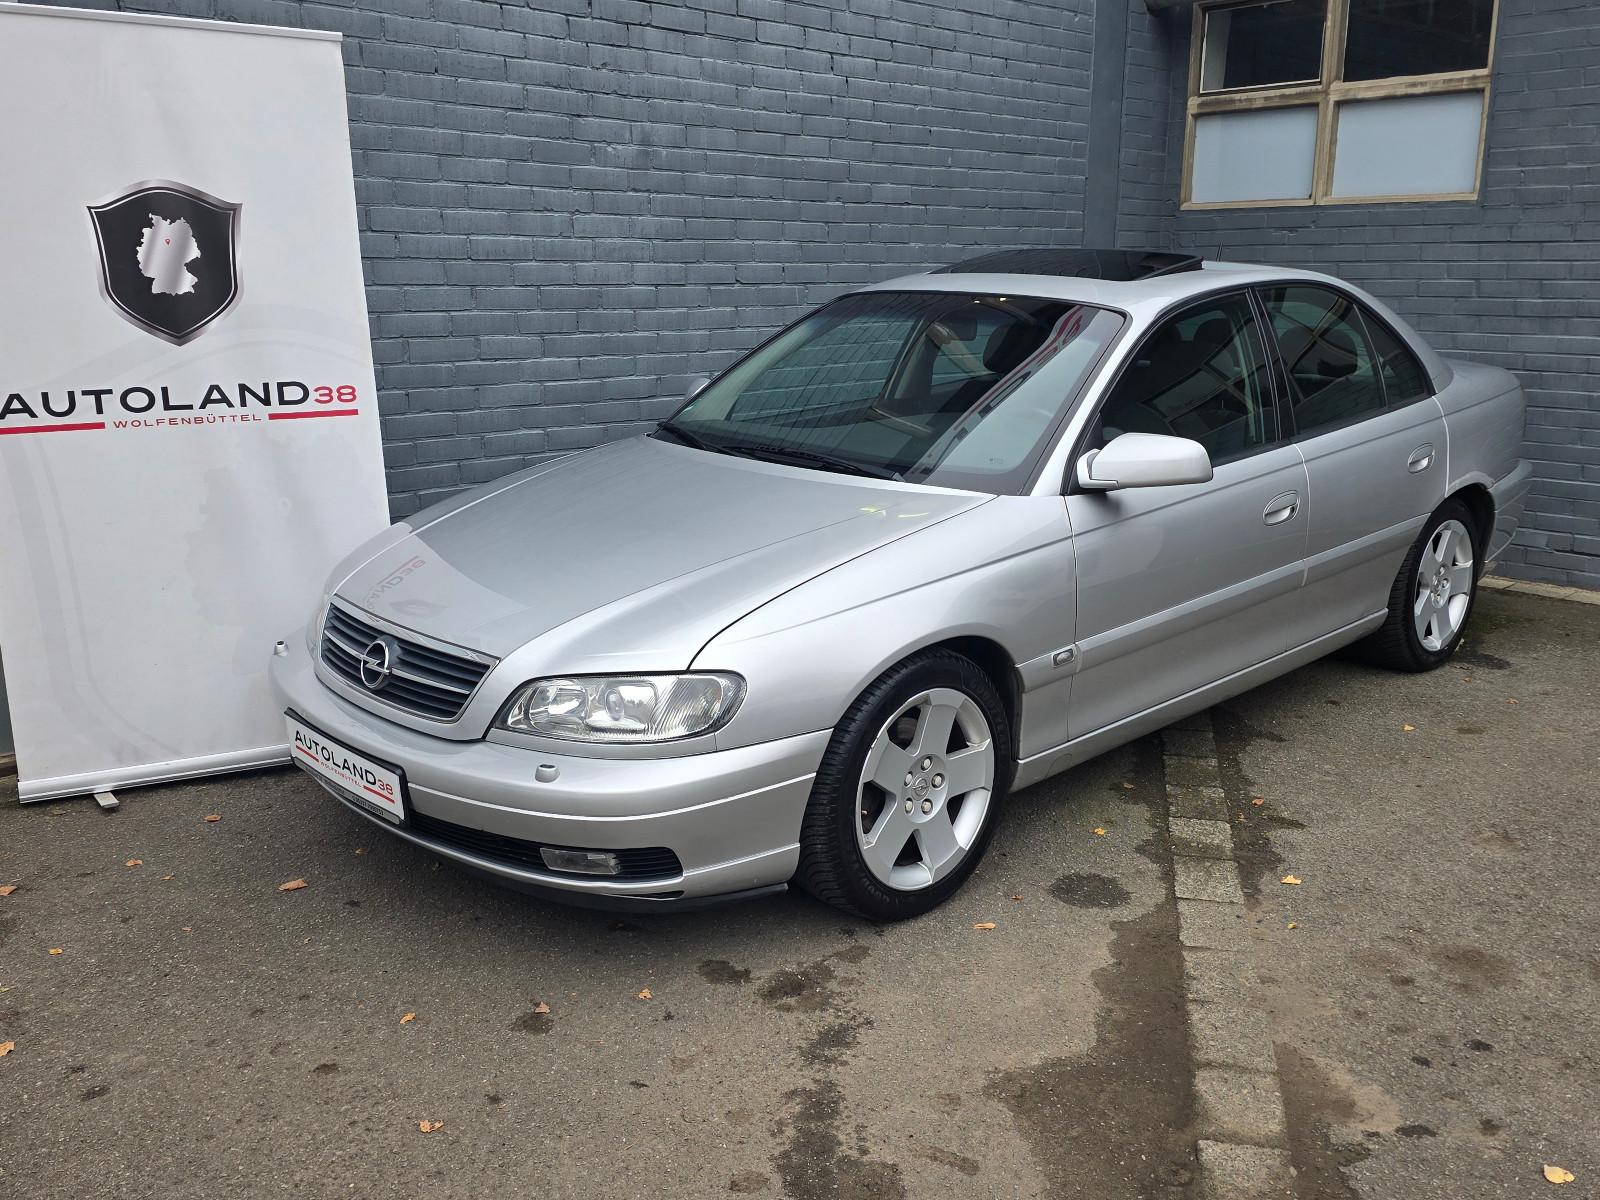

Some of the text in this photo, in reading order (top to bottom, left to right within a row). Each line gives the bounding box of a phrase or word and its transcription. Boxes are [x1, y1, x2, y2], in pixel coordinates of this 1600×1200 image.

[0, 381, 357, 420] AUTOLAND38
[113, 413, 262, 428] WOLFENBÜTTEL
[295, 730, 394, 796] AUTOLAND38
